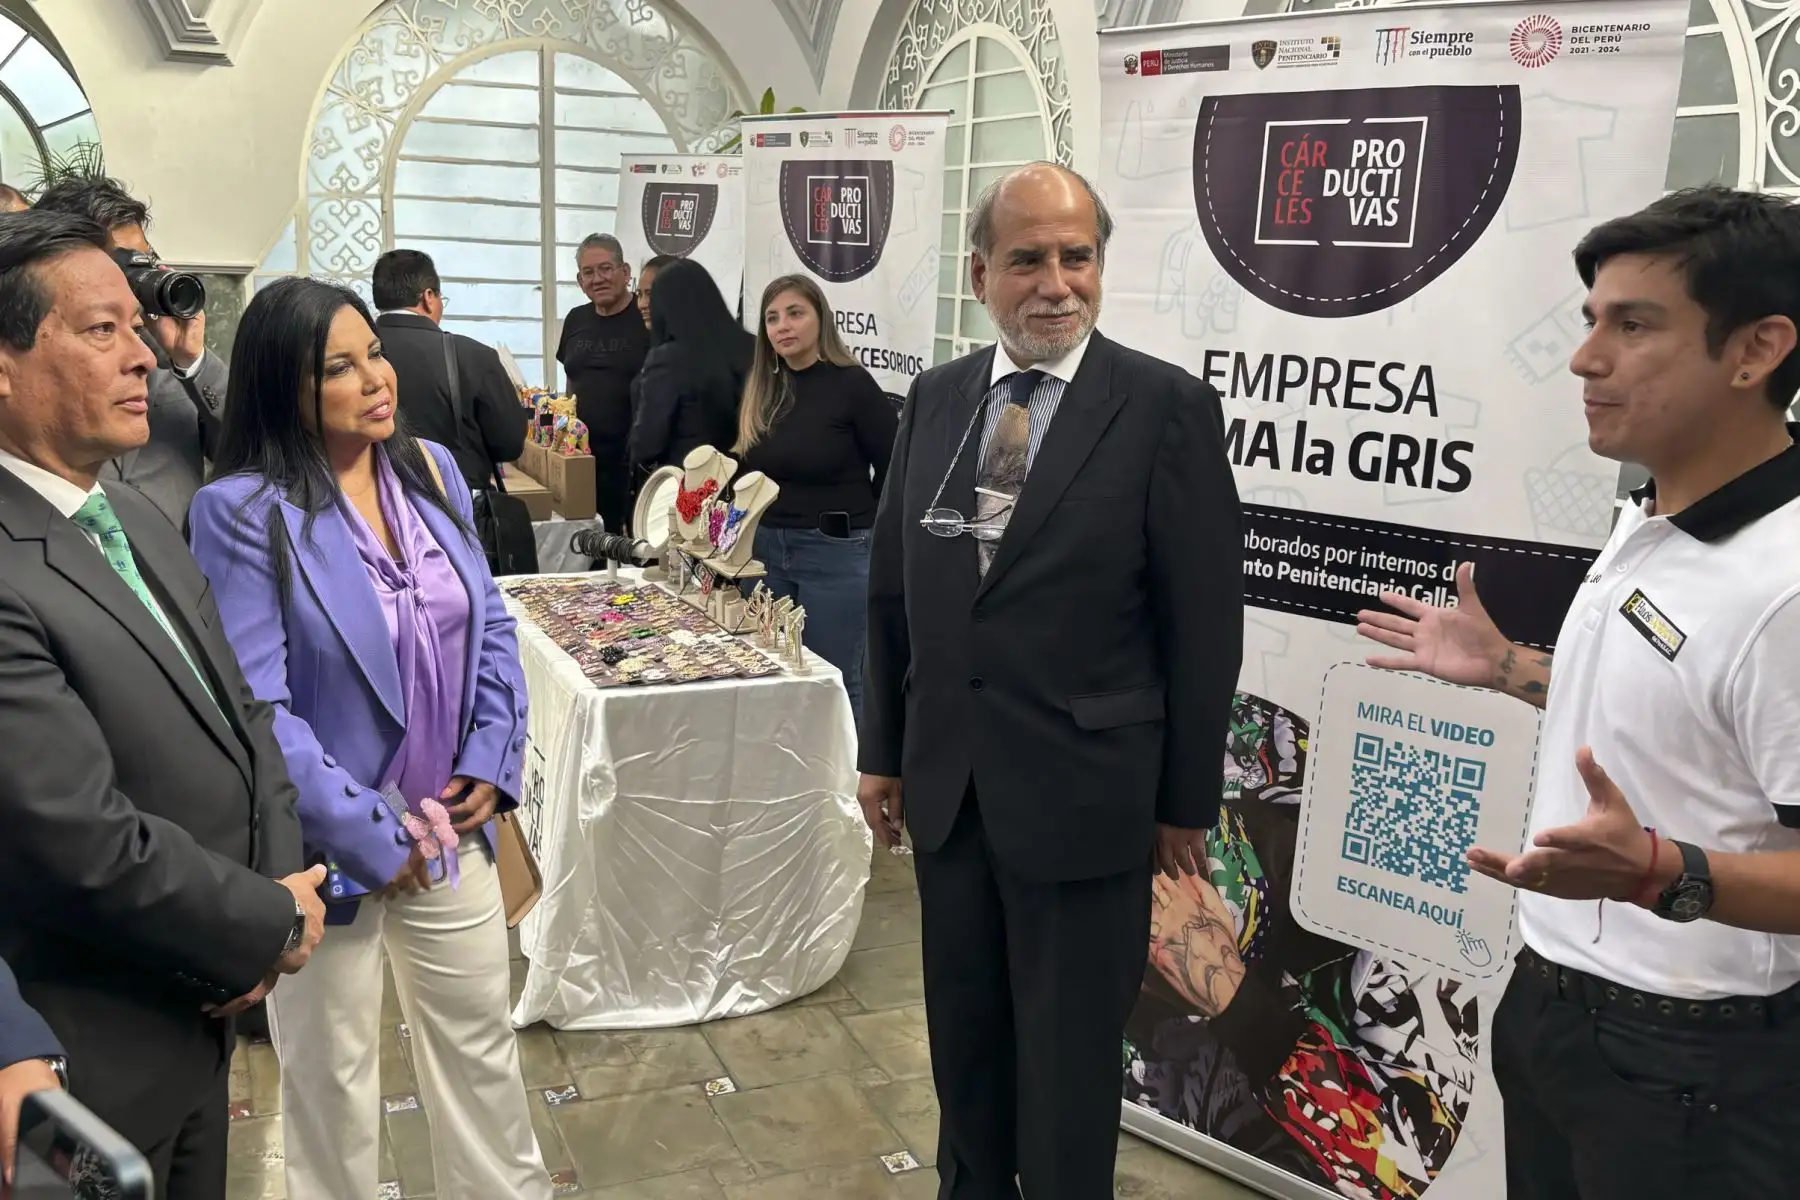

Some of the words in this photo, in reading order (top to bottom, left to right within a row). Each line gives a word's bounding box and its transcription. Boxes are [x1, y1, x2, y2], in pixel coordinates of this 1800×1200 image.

[1571, 23, 1651, 34] BICENTENARIO
[1279, 38, 1315, 46] INSTITUTO
[1410, 30, 1474, 46] Siempre
[1570, 35, 1590, 44] DEL
[1593, 33, 1622, 44] PERÚ
[1278, 46, 1313, 54] NACIONAL
[1278, 53, 1328, 61] PENITENCIARIO
[1422, 48, 1429, 56] el
[1429, 44, 1473, 59] pueblo
[1142, 58, 1160, 68] PERÚ
[1280, 133, 1328, 168] CÁR
[1351, 138, 1406, 168] PRO
[1277, 169, 1305, 196] CE
[1322, 168, 1403, 197] DUCTI
[840, 187, 862, 203] PRO
[680, 199, 694, 210] PRO
[815, 203, 826, 218] CE
[830, 202, 861, 219] DUCTI
[1274, 197, 1313, 225] LES
[1349, 197, 1400, 227] VAS
[673, 209, 693, 220] DUCTI
[678, 219, 692, 231] VAS
[814, 218, 831, 233] LES
[841, 218, 862, 235] VAS
[835, 310, 878, 336] RESA
[1203, 349, 1439, 418] EMPRESA
[1291, 420, 1335, 477] la
[1348, 431, 1475, 493] GRIS
[1324, 546, 1358, 566] por
[1360, 546, 1438, 578] internos
[1442, 560, 1476, 582] dl
[1277, 560, 1407, 597] Penitenciario
[1357, 701, 1404, 728] MIRA
[1408, 712, 1427, 734] EL
[1431, 718, 1495, 748] VIDEO
[1337, 875, 1416, 914] ESCANEA
[1418, 900, 1465, 929] AQUÍ
